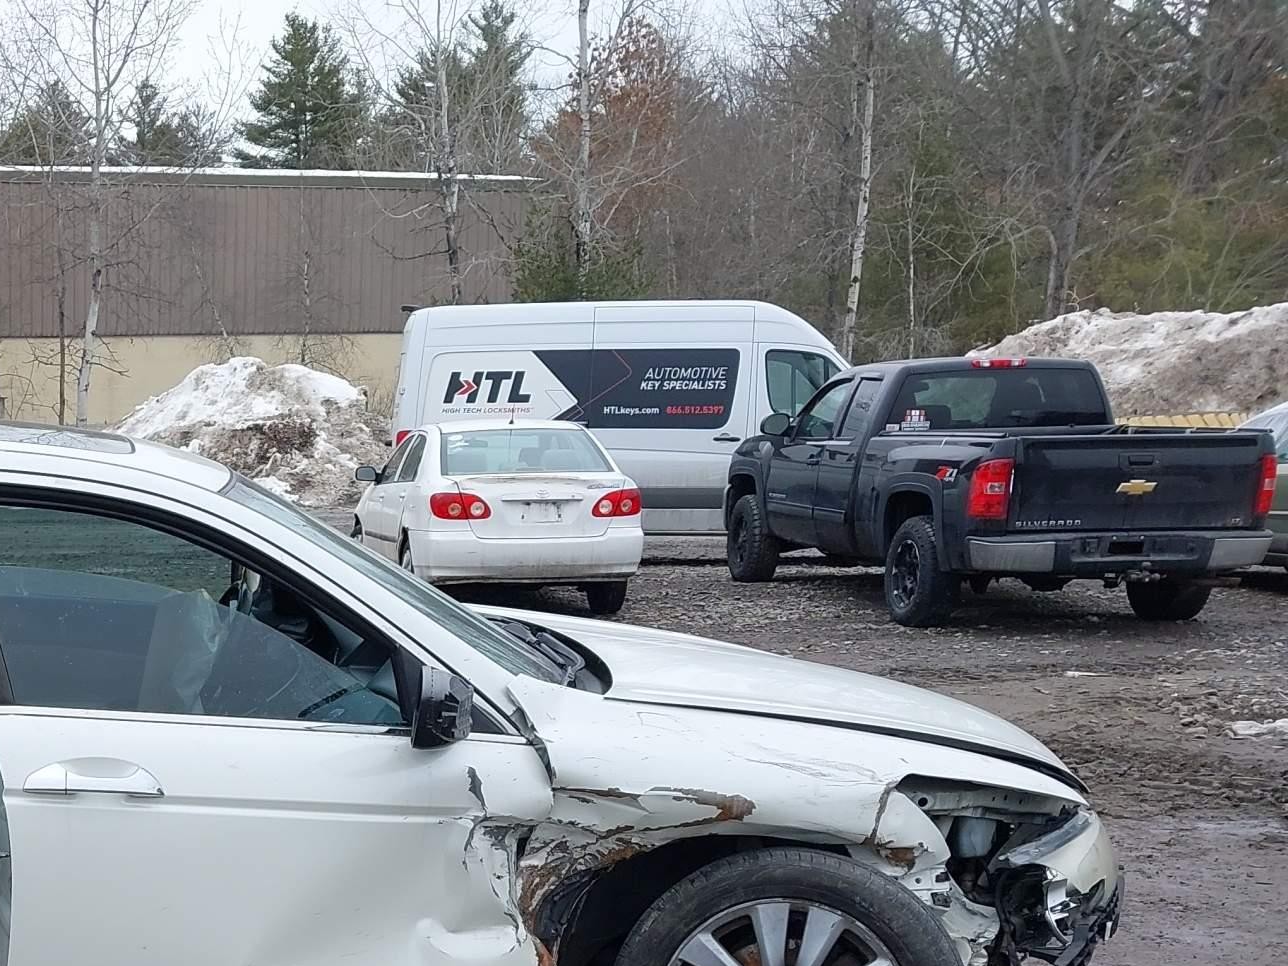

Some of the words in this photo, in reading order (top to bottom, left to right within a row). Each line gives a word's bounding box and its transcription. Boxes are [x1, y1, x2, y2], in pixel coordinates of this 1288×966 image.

[644, 367, 729, 379] AUTOMOTIVE
[443, 371, 531, 404] HTL
[640, 381, 662, 391] KEY
[662, 380, 727, 390] SPECIALISTS
[603, 406, 660, 415] HTLkeys.com
[1015, 520, 1081, 528] SILVERADO
